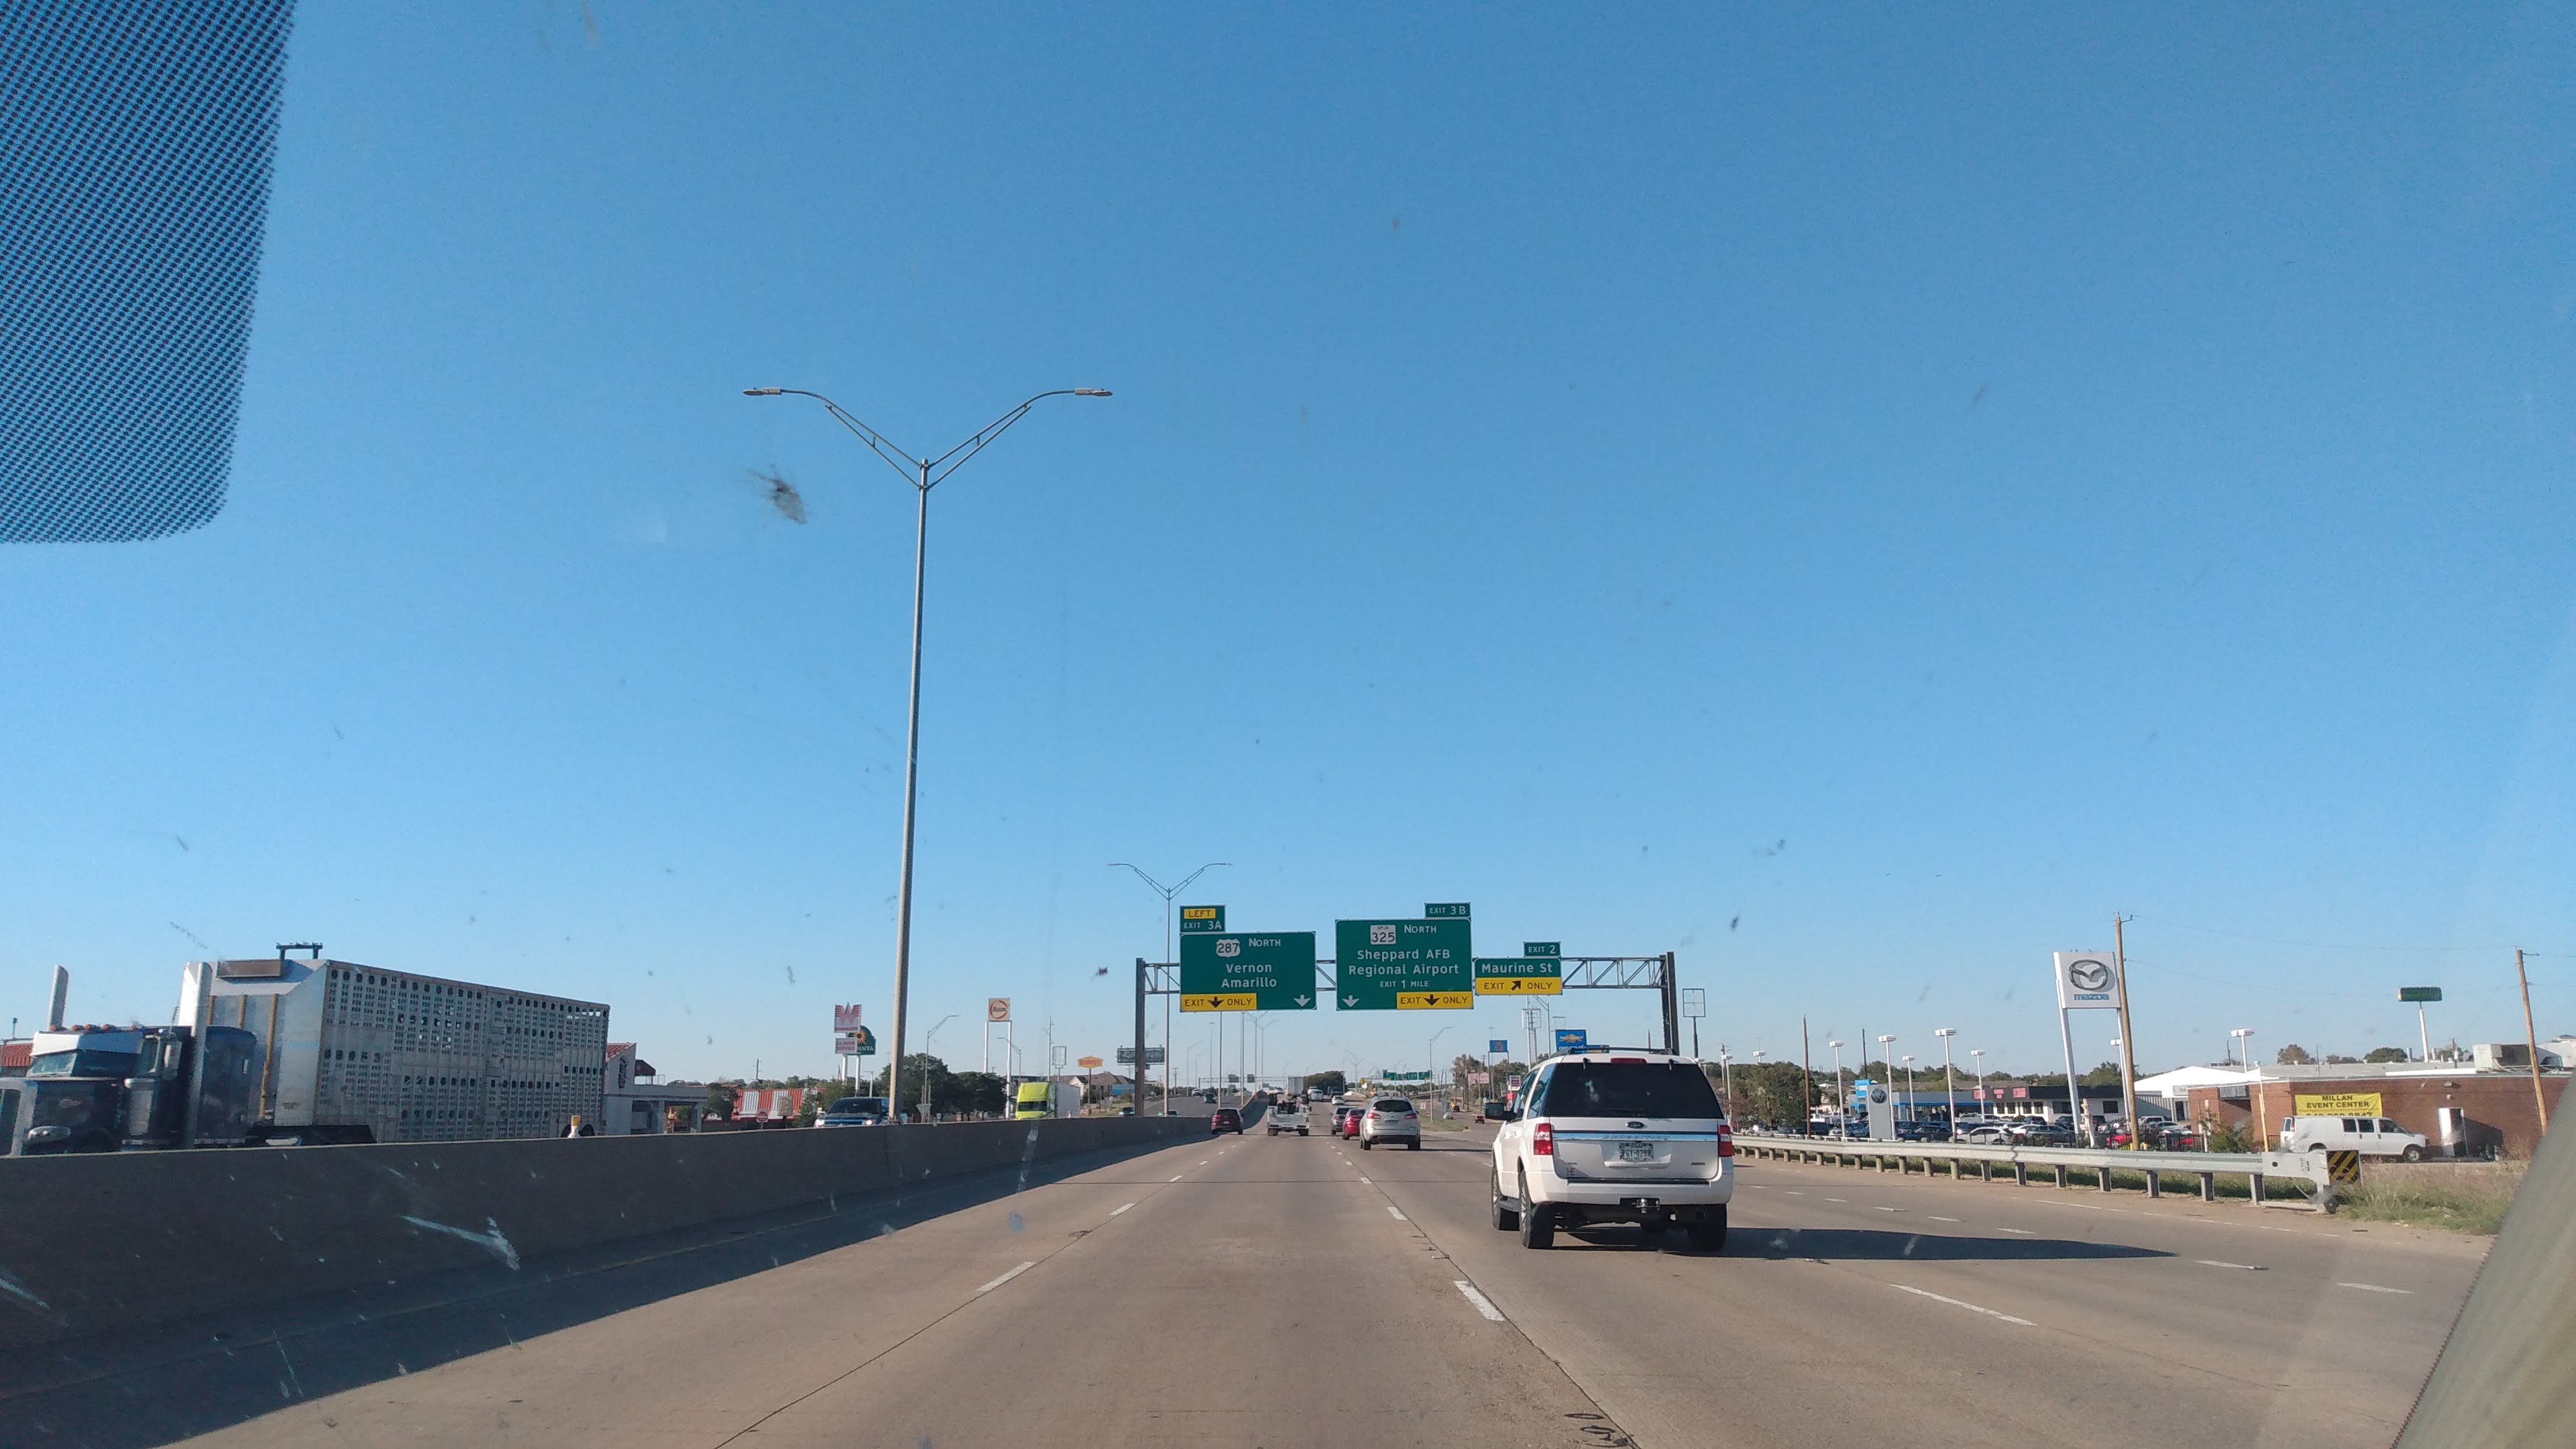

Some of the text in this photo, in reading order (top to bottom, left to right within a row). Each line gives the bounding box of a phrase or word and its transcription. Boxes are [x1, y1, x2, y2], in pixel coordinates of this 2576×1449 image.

[1188, 910, 1211, 918] LEFT
[1183, 920, 1222, 930] EXIT 3A
[1372, 924, 1437, 942] 325 NORTH
[1217, 938, 1281, 954] 287 NORTH
[1549, 945, 1556, 954] 2
[1357, 949, 1451, 962] Sheppard AFB
[1226, 964, 1273, 973] Vernon
[1349, 963, 1460, 978] Regional Airport
[1481, 962, 1553, 973] Maurine St
[1221, 977, 1277, 988] Amarillo
[1380, 980, 1397, 988] EXIT
[1401, 979, 1406, 989] 1
[1484, 981, 1553, 990] EXIT ONLY
[1185, 998, 1253, 1007] EXIT ONLY
[1400, 996, 1468, 1004] EXIT ONLY
